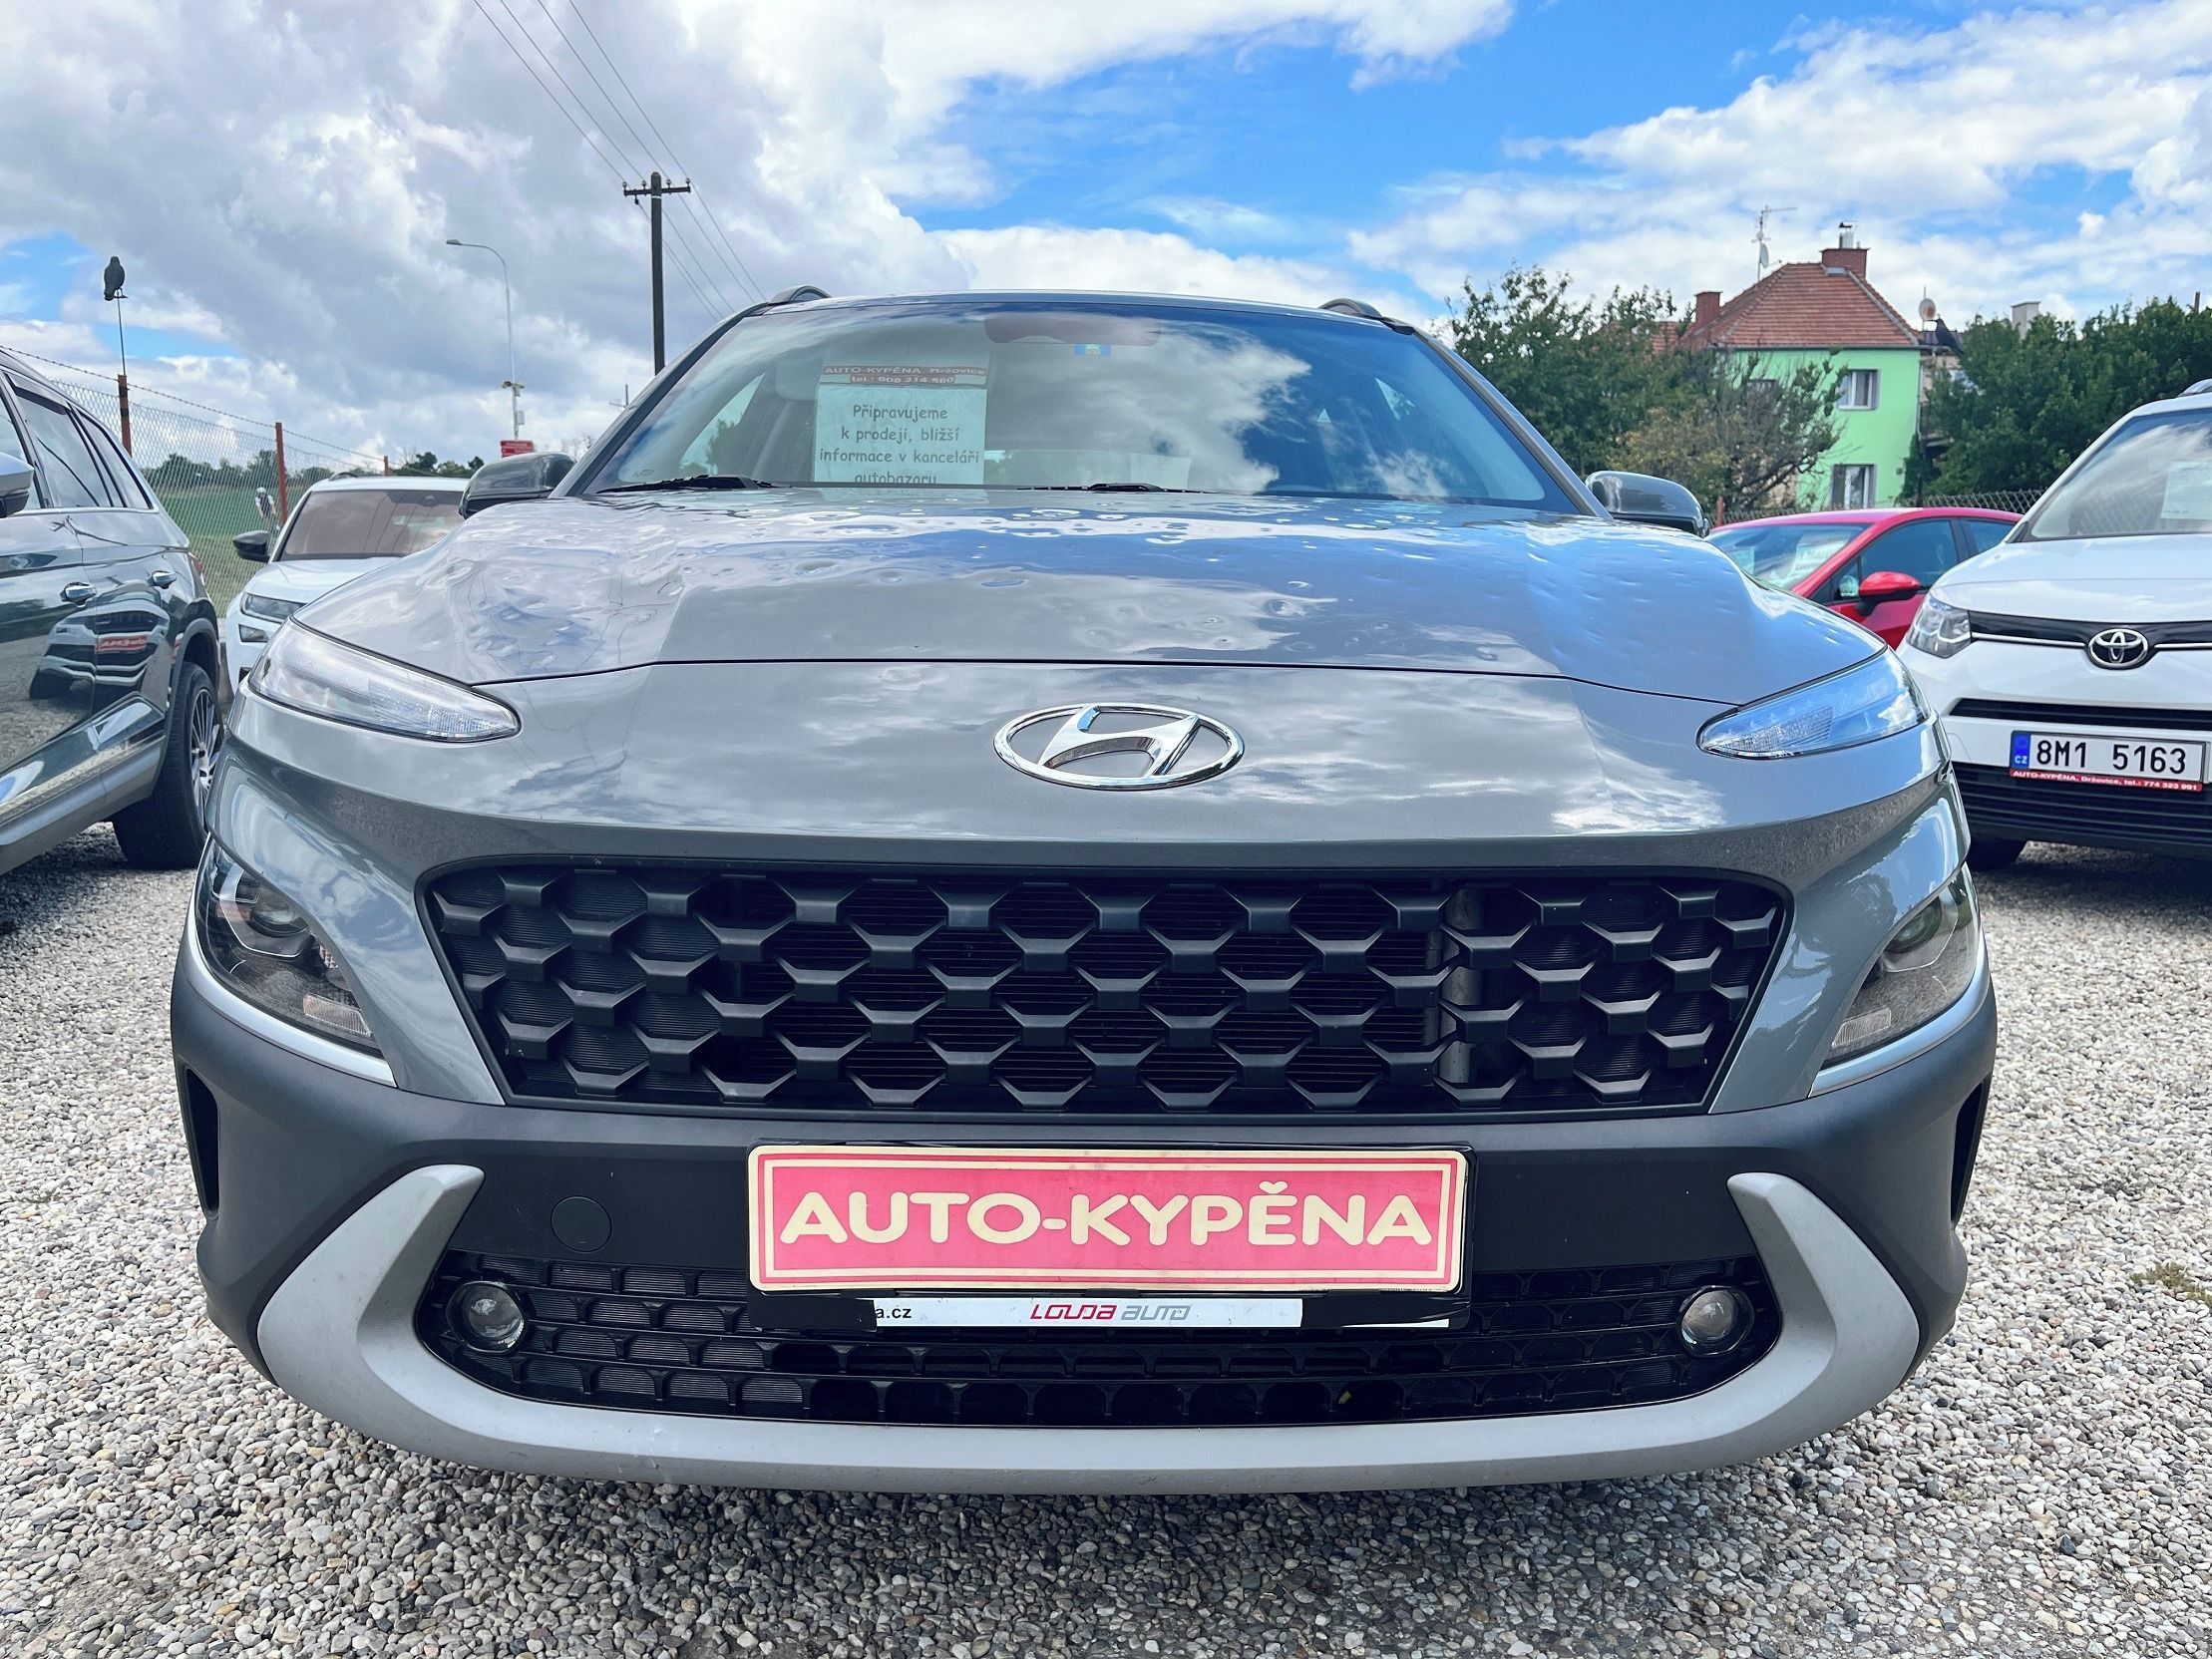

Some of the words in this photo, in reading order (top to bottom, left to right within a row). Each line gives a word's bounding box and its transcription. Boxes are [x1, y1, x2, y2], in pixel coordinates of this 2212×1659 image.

[853, 404, 948, 423] Připravujeme
[841, 426, 850, 440] k
[856, 427, 914, 445] prodeji,
[921, 427, 960, 442] bližší
[819, 448, 893, 463] informace
[899, 453, 907, 463] v
[914, 449, 980, 465] kanceláři
[855, 471, 937, 484] autobazaru
[2014, 755, 2028, 765] CZ
[2036, 740, 2086, 769] 8M1
[2112, 744, 2186, 775] 5163
[781, 1180, 1432, 1246] AUTO-KYPĚNA
